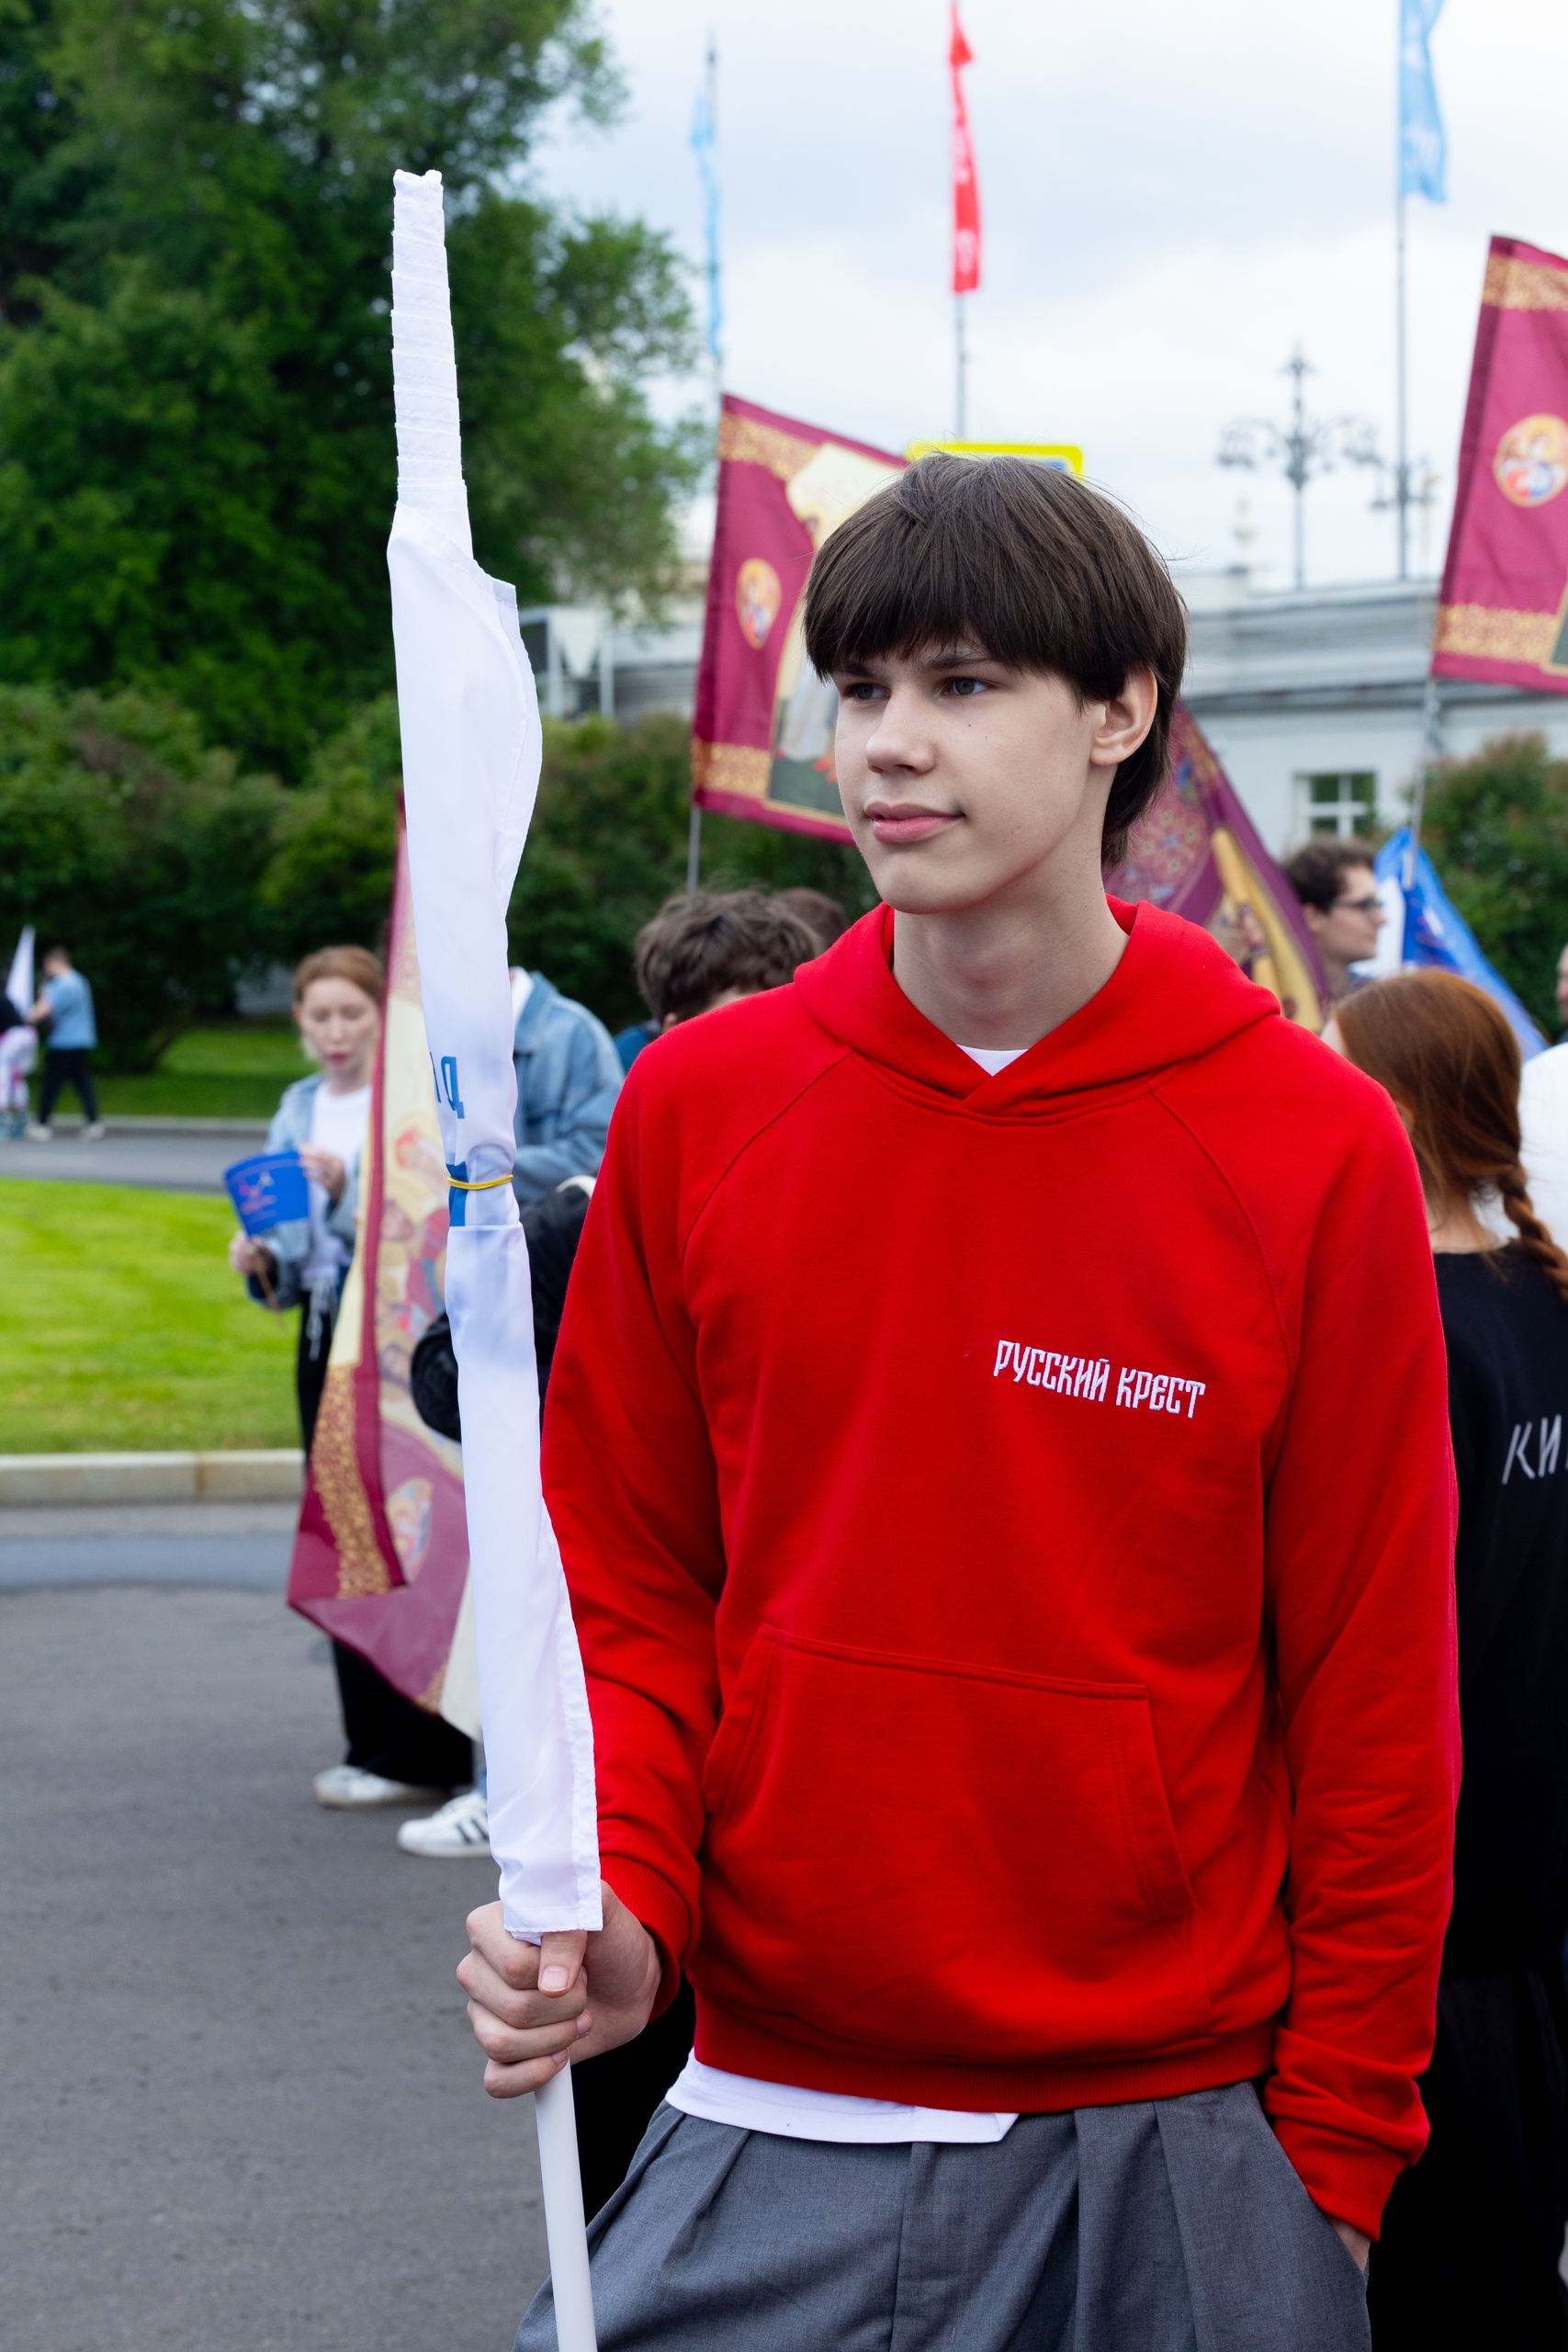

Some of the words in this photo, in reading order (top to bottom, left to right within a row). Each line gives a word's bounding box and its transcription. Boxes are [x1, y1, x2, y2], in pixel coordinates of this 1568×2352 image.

[993, 1340, 1110, 1402] РУССКИЙ
[1115, 1366, 1205, 1419] КРЕСТ
[1501, 1413, 1568, 1486] КИ
